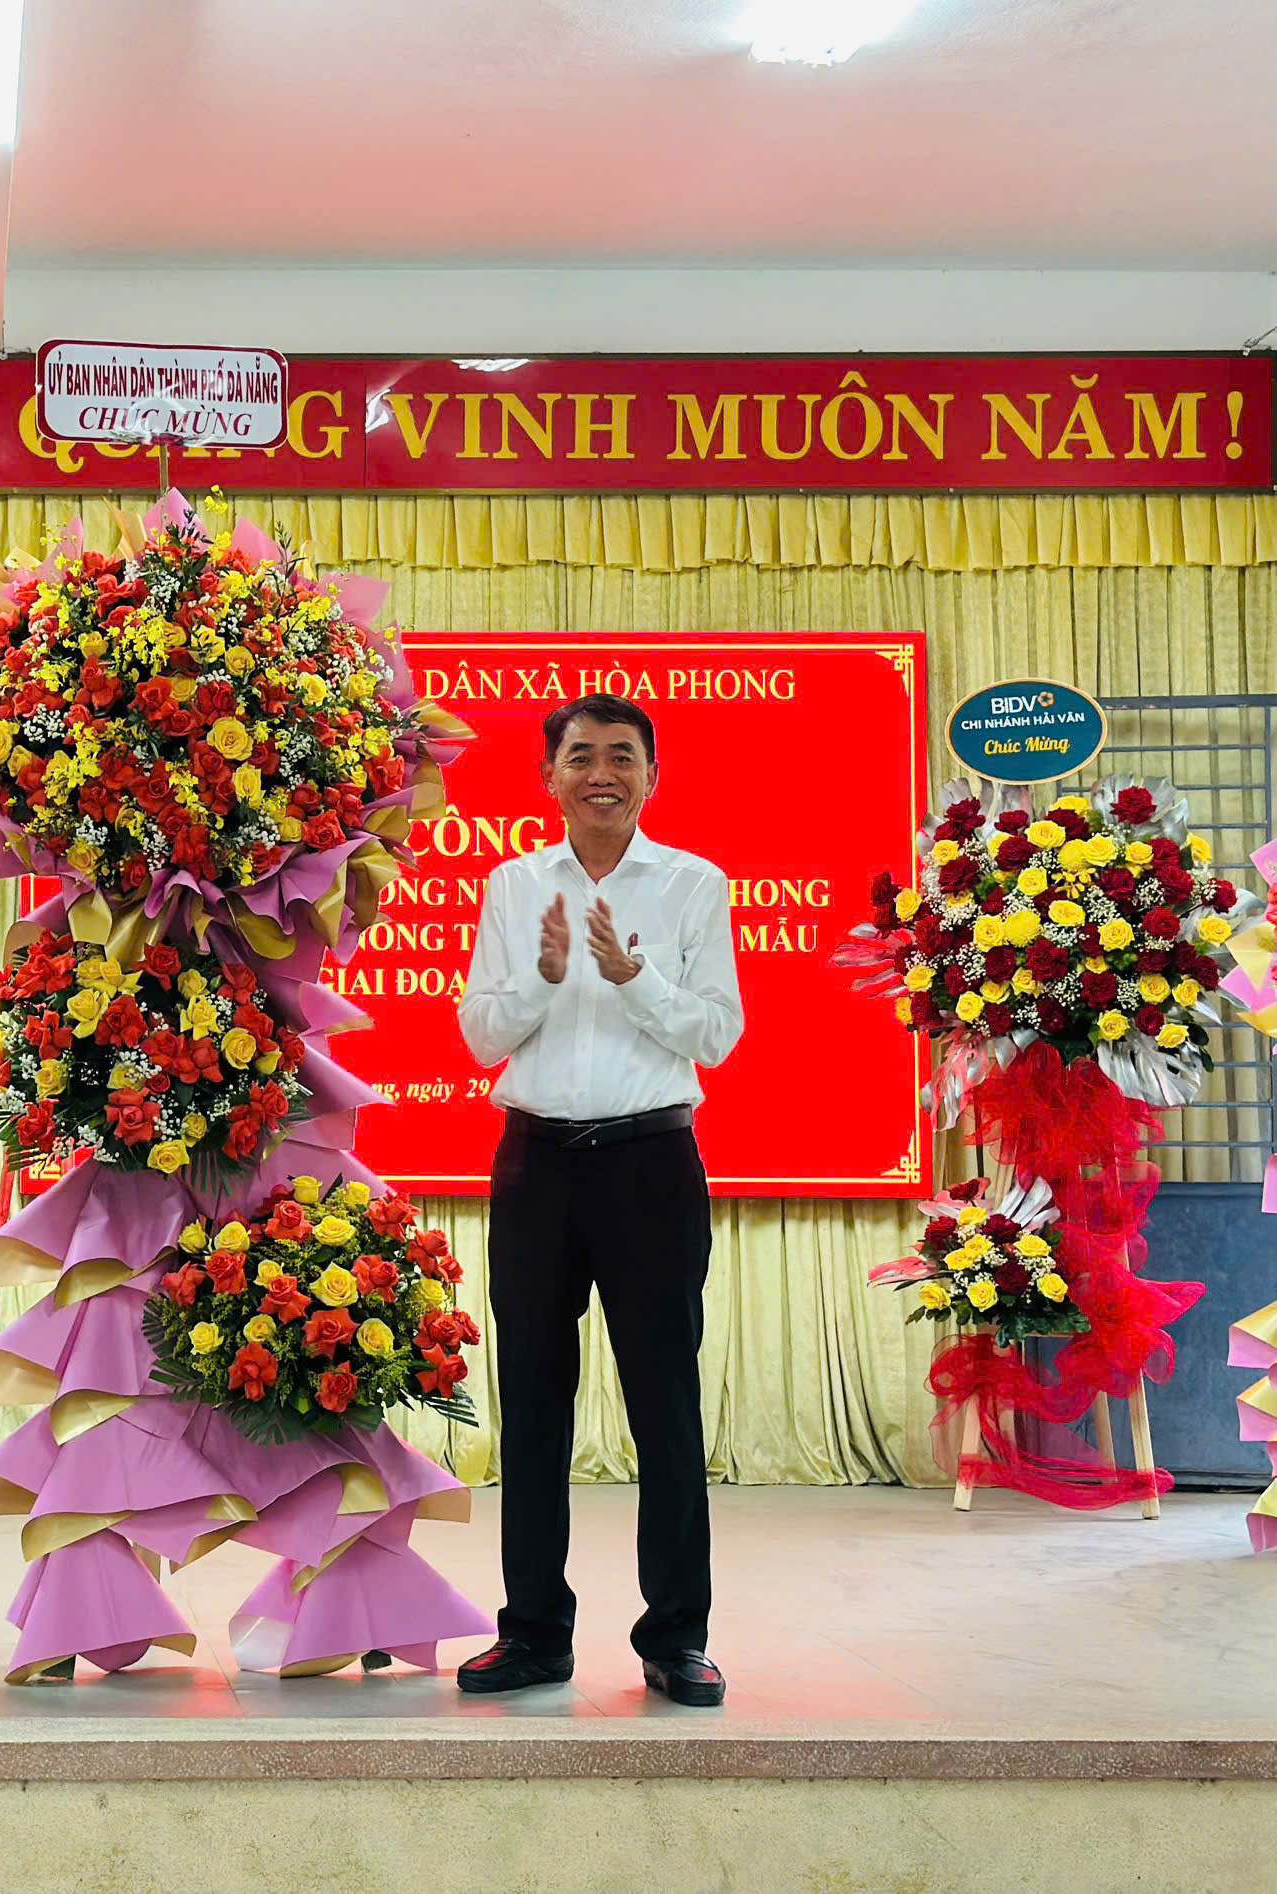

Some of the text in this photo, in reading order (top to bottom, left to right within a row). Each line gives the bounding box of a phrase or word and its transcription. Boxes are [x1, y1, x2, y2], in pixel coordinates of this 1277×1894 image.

[66, 363, 91, 397] BAN
[93, 356, 127, 398] NHÂN
[130, 357, 155, 399] DÂN
[157, 359, 198, 400] THÀNH
[201, 358, 224, 402] PHỐ
[227, 362, 242, 403] ĐÀ
[246, 356, 279, 405] NẴNG
[78, 401, 253, 436] CHÚC MỪNG
[382, 392, 635, 460] VINH
[667, 370, 946, 460] MUÔN
[423, 661, 504, 699] DÂN
[514, 662, 568, 699] XÃ
[578, 660, 659, 700] HÒA
[666, 669, 796, 700] PHONG
[990, 695, 1039, 714] BIDV
[961, 711, 1085, 730] CHI NHÁNH HẢI VÂN
[984, 736, 1071, 755] Chúc Mừng
[728, 879, 831, 907] HONG
[407, 1077, 454, 1103] ngày
[466, 1077, 490, 1098] 29
